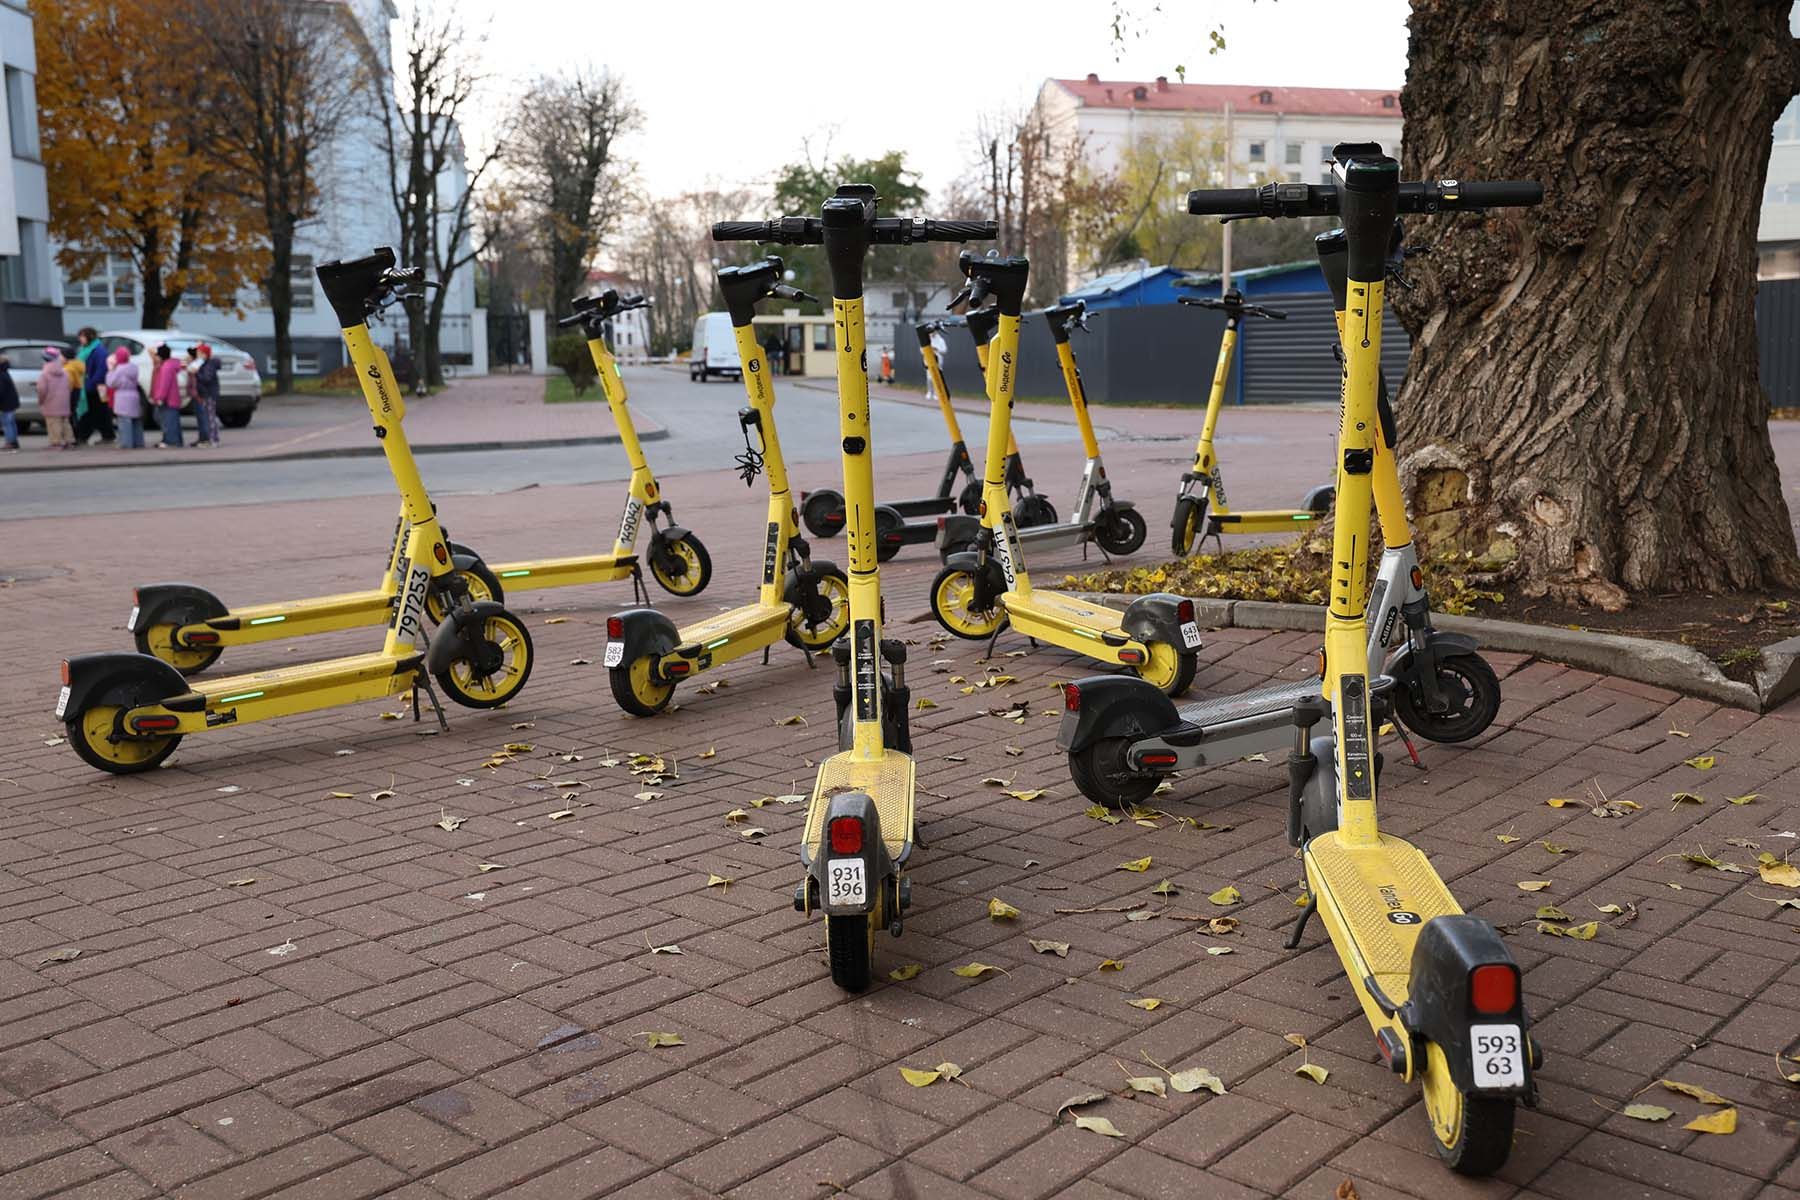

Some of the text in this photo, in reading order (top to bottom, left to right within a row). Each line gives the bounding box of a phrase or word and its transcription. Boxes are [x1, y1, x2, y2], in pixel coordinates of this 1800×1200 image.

[398, 567, 429, 637] 797253
[1183, 625, 1197, 635] 643
[1186, 634, 1198, 643] 711
[833, 867, 860, 880] 931
[832, 882, 862, 897] 396
[1378, 884, 1416, 924] Yandex Go
[1478, 1036, 1516, 1053] 593
[1486, 1057, 1512, 1074] 63
